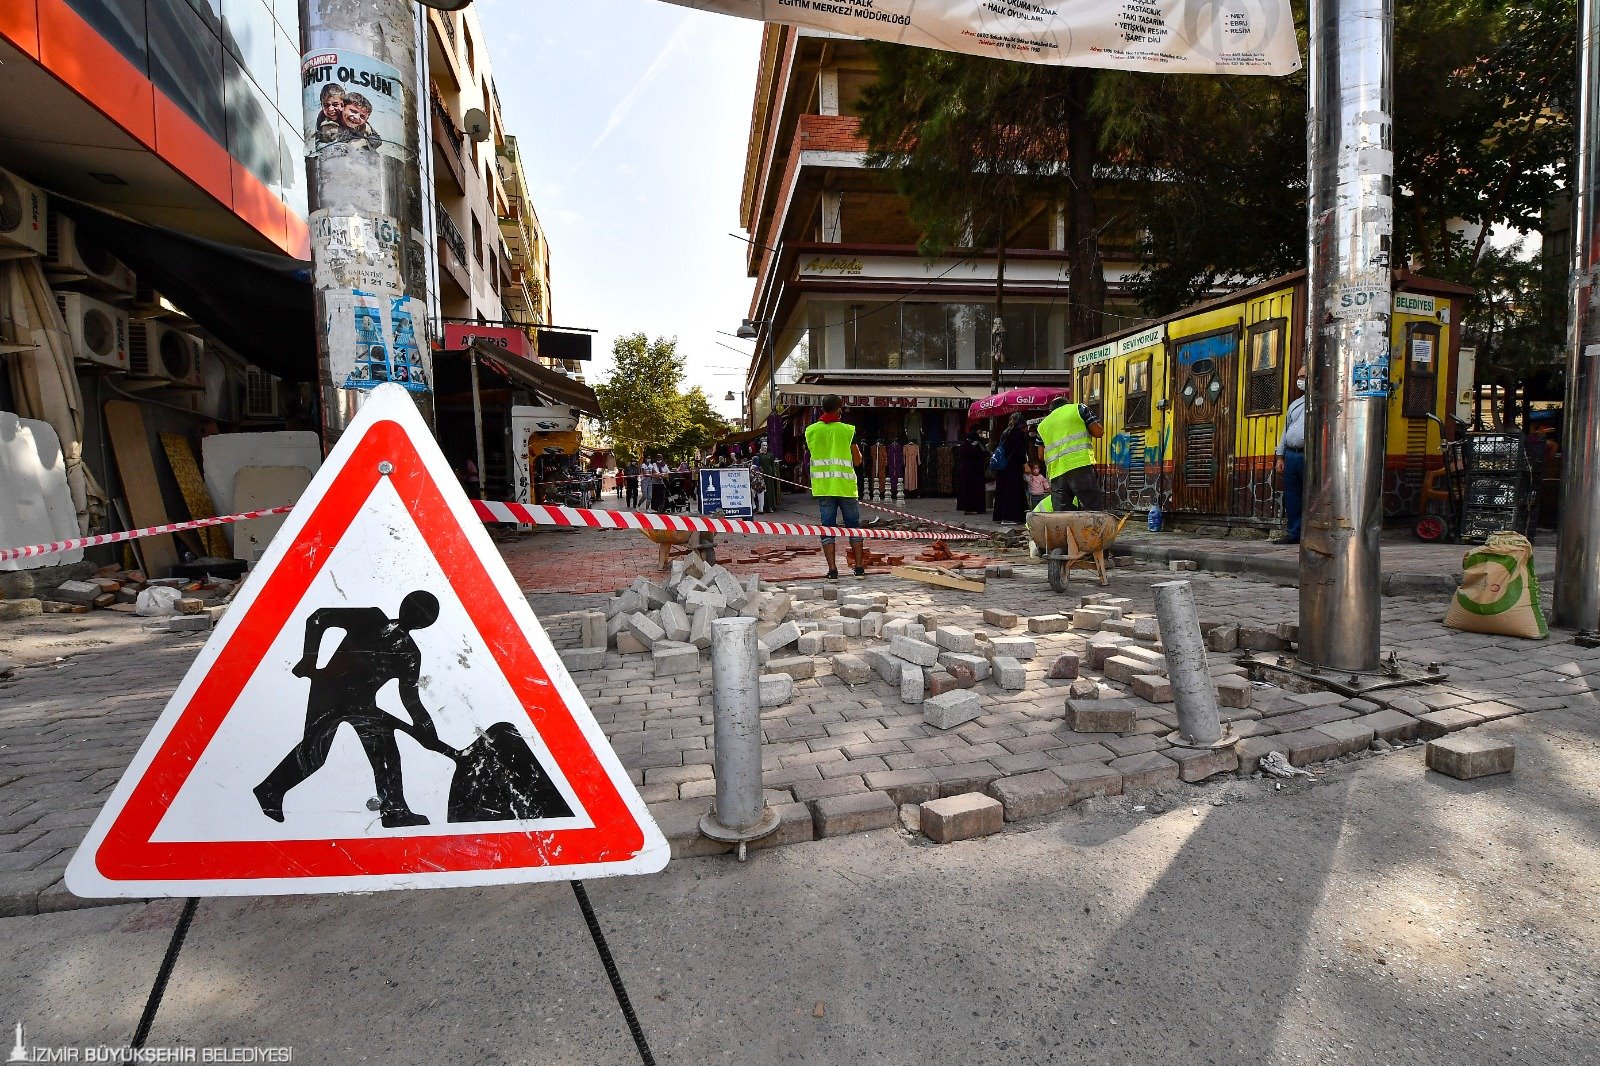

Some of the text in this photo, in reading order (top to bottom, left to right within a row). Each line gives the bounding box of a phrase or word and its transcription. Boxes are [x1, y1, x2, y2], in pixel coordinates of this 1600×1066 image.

[812, 2, 852, 16] MERKEZİ
[854, 9, 911, 25] MÜDÜRLÜĞÜ
[988, 3, 1006, 15] HALK
[1032, 5, 1058, 15] YAZMA
[1128, 5, 1161, 16] PASTACILIK
[1123, 13, 1136, 21] TAKI
[337, 66, 392, 97] OLSUN
[1396, 296, 1434, 312] BELEDİYESİ
[1122, 331, 1159, 351] SEVİYORUZ
